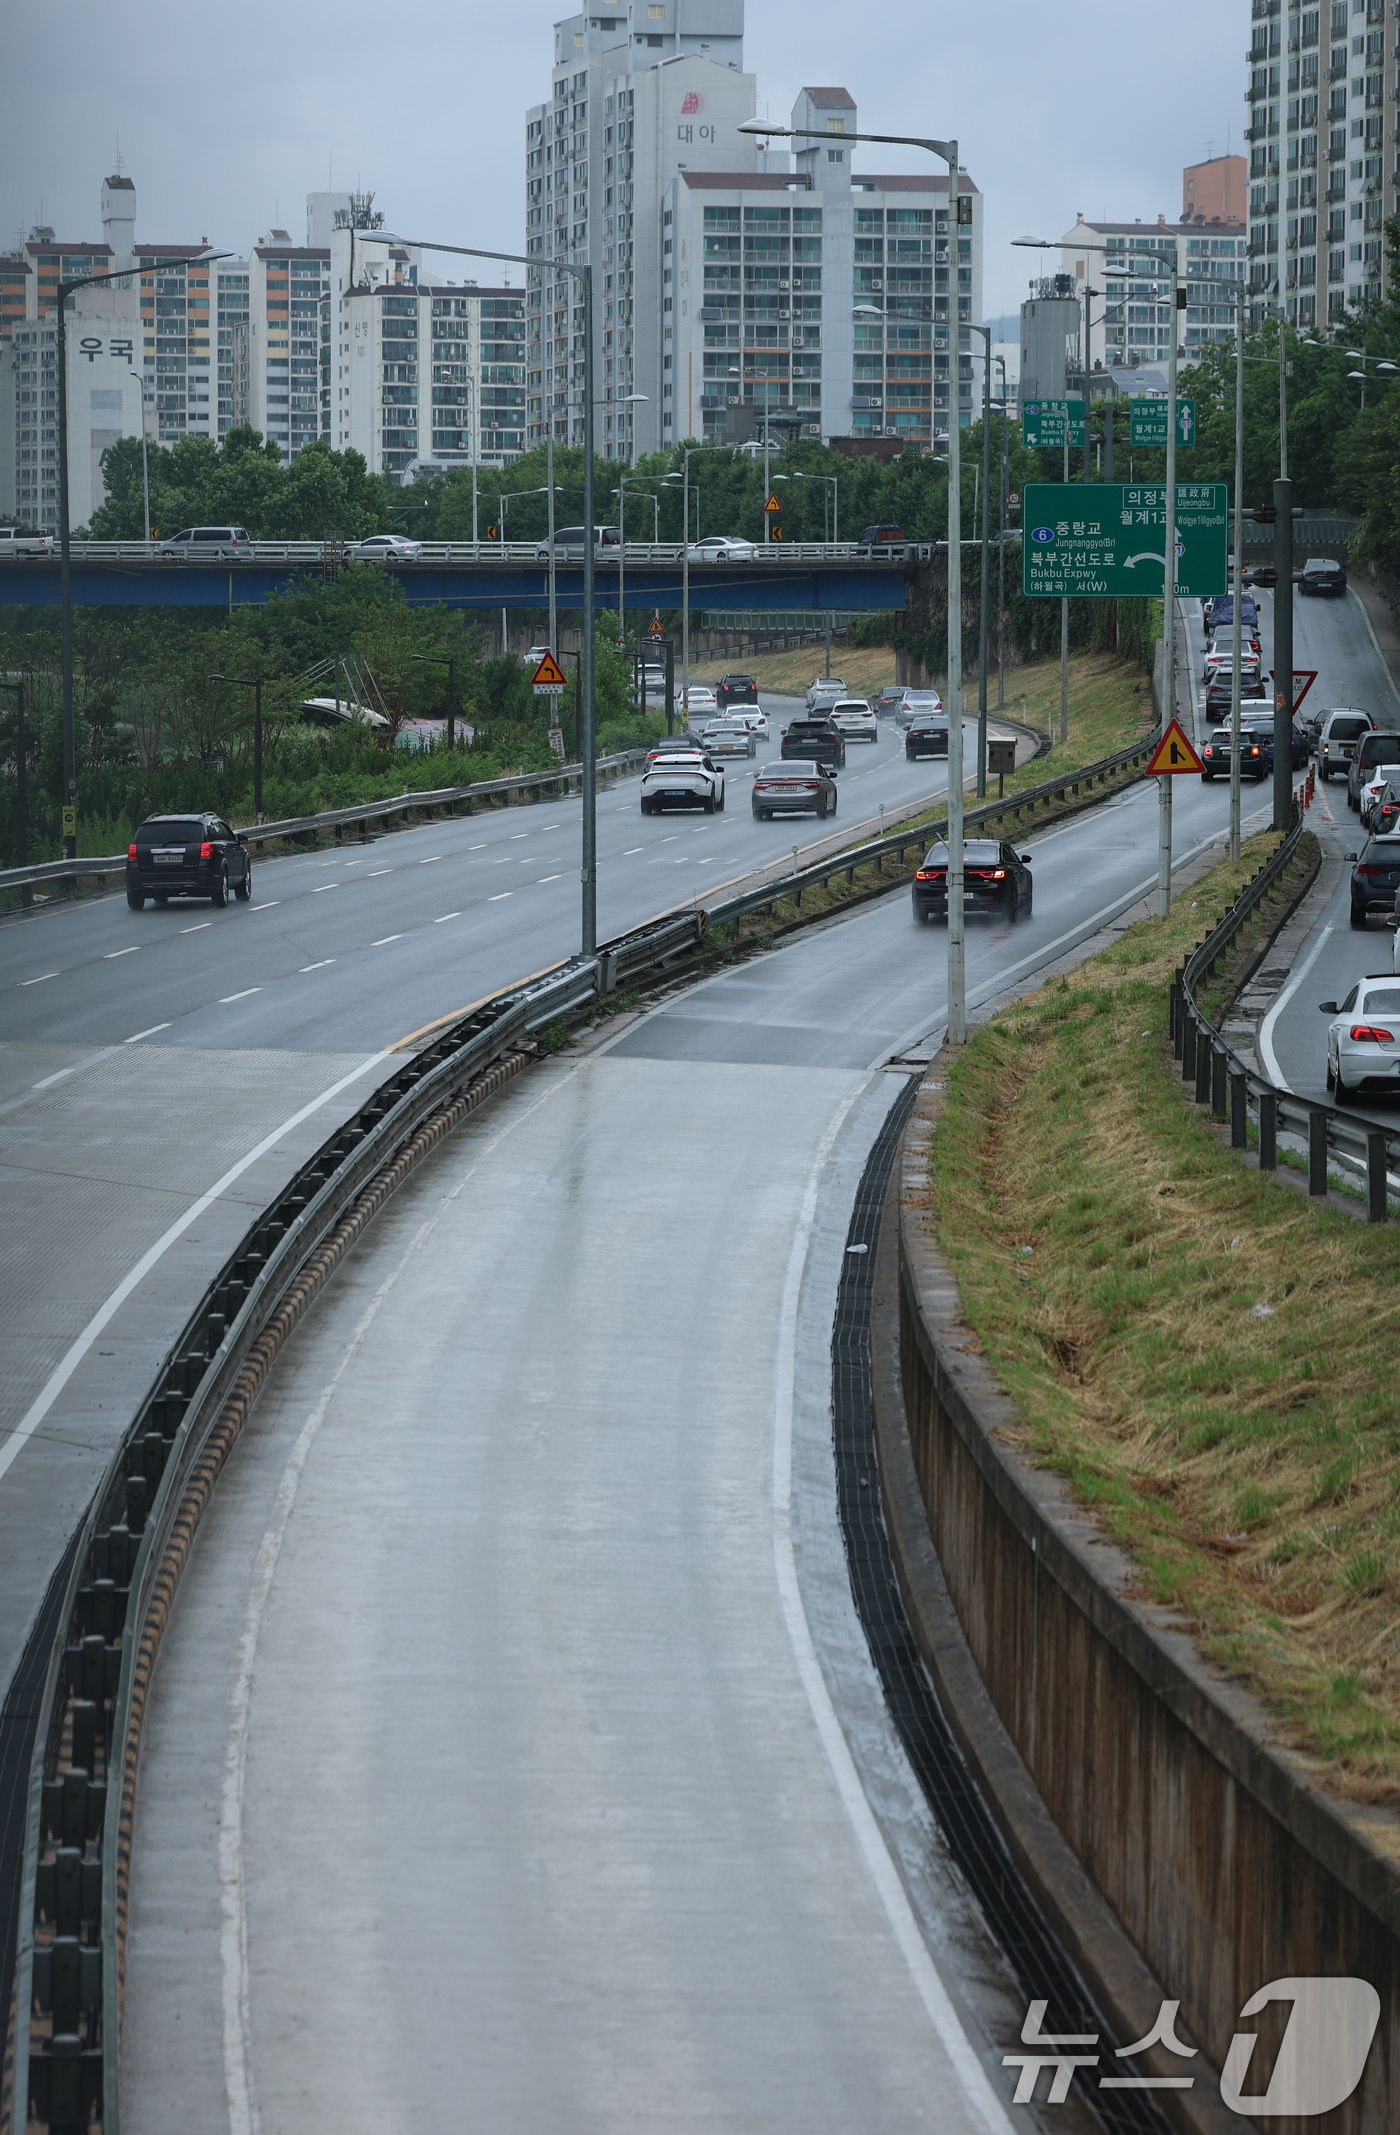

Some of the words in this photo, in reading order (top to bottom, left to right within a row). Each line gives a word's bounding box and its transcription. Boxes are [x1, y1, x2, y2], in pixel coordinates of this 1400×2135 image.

[677, 125, 716, 143] 대아
[79, 338, 133, 365] 우국
[1133, 407, 1156, 416] 의정부
[1135, 424, 1165, 433] 월계1교
[1177, 499, 1211, 508] Uijeongbu
[1177, 515, 1197, 527] Wolgye
[1055, 521, 1101, 536] 중랑교
[1038, 529, 1047, 541] 6
[1055, 537, 1116, 549] Jungnanggyo(Br)
[1031, 552, 1115, 567] 북부간선도로
[1030, 568, 1062, 578] Bukbu
[1064, 568, 1097, 579] Expwy
[1030, 581, 1067, 591] (하월곡)
[1076, 581, 1107, 591] 서(W)
[1161, 584, 1190, 594] 10m
